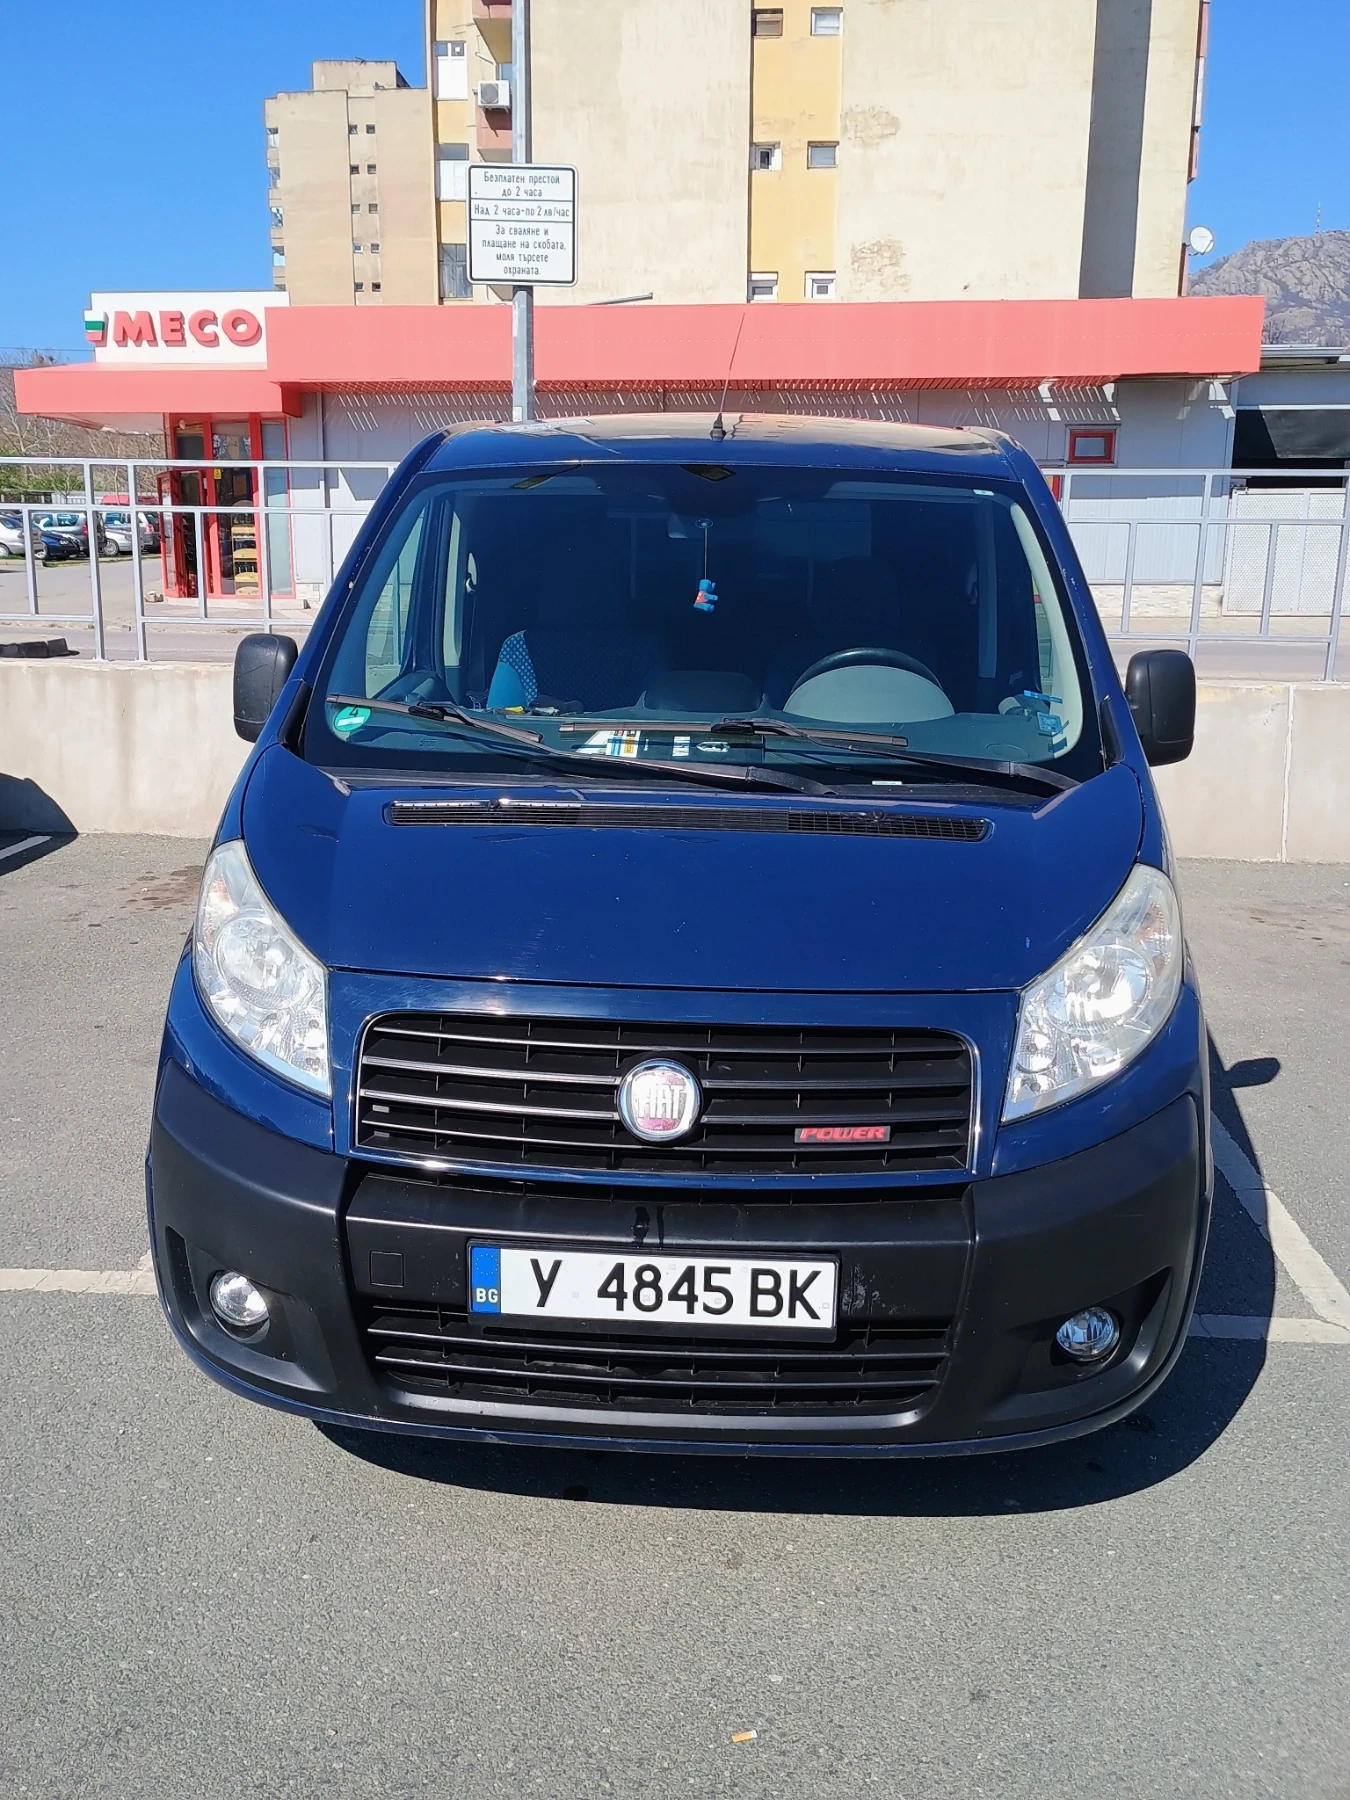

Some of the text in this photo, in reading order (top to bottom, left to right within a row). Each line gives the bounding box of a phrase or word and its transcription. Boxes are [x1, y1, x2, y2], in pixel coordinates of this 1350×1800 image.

[484, 171, 560, 186] Безплатен престой
[502, 186, 543, 197] до 2 часа
[474, 204, 490, 216] Над
[494, 205, 499, 215] 2
[537, 206, 542, 216] 2
[544, 207, 570, 217] лв/час
[495, 224, 549, 236] За сваляне и
[482, 239, 517, 249] плащане
[520, 240, 530, 249] на
[496, 253, 549, 264] моля търсете
[113, 309, 262, 347] МЕСО
[349, 705, 358, 717] 4
[800, 1126, 886, 1141] POWER
[475, 1288, 499, 1303] BG
[597, 1262, 734, 1316] 4845
